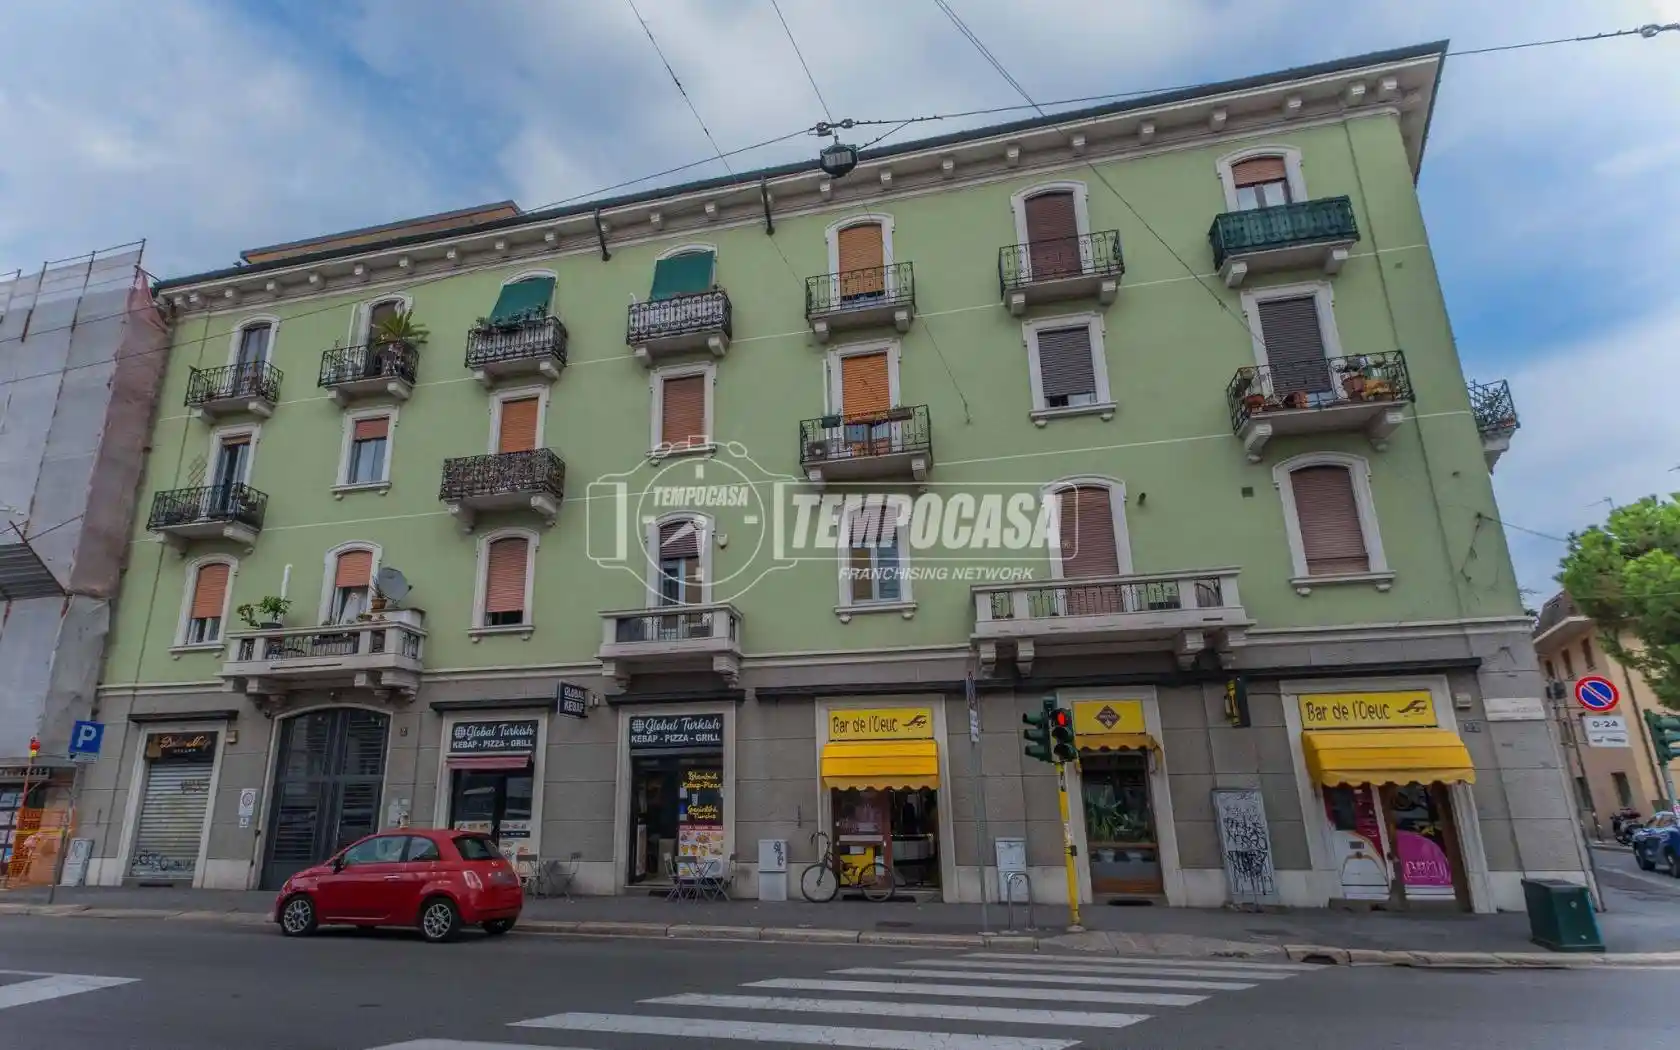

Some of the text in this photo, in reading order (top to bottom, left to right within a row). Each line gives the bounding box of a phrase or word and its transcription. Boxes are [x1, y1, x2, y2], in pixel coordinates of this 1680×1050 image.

[564, 687, 584, 699] GLOBAL
[564, 701, 583, 713] KEBAP
[1306, 701, 1328, 721] Bar
[1331, 701, 1349, 720] de
[645, 717, 720, 734] Global Turkish
[832, 716, 850, 734] Bar
[852, 717, 866, 733] de
[1592, 720, 1618, 728] 0-24
[76, 725, 97, 748] P
[466, 723, 534, 740] Global Turkish
[631, 735, 658, 743] KEBAP
[665, 734, 688, 742] PIZZA
[695, 733, 720, 742] GRILL
[453, 741, 477, 749] KEBAP
[483, 740, 505, 748] PIZZA
[511, 739, 533, 747] GRILL
